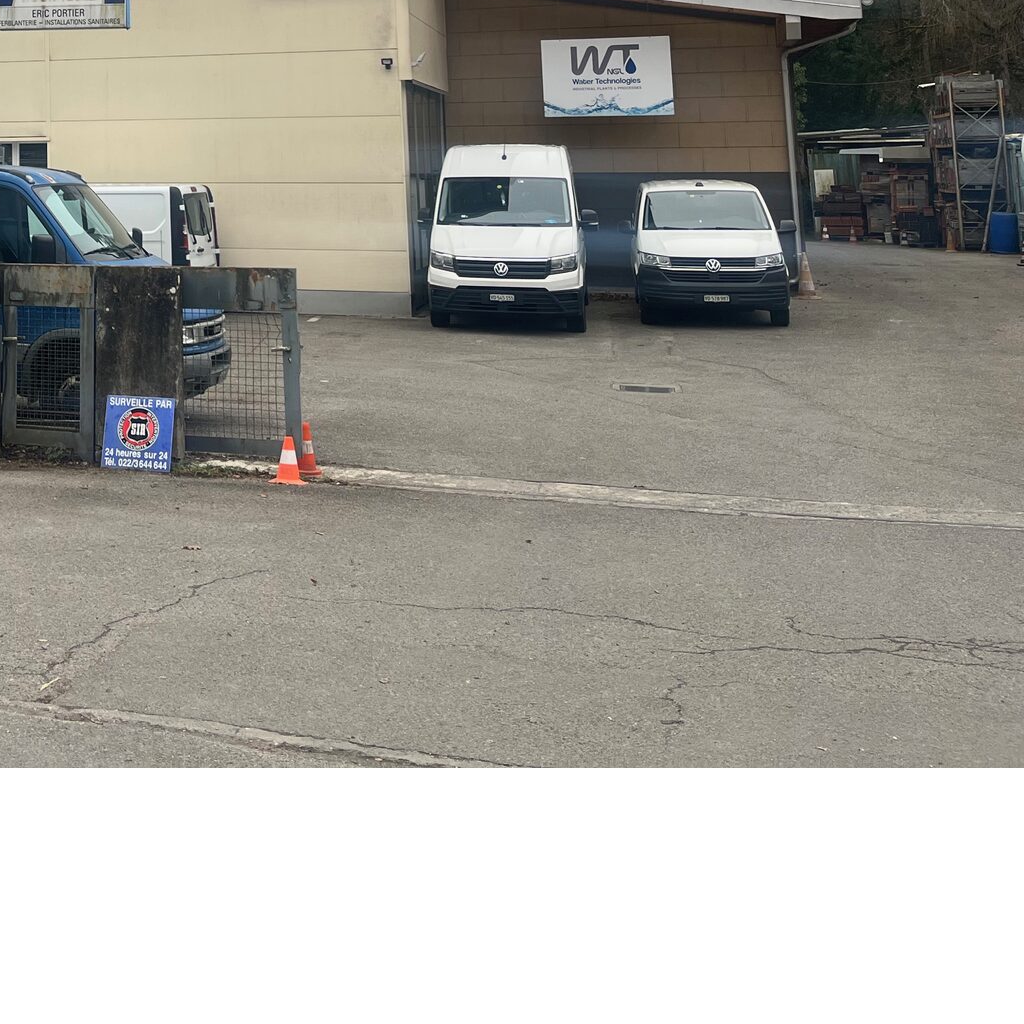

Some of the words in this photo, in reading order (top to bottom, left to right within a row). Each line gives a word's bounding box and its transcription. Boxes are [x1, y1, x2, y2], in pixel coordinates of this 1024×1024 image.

[32, 9, 50, 18] ERIC
[52, 8, 85, 18] PORTIER
[44, 18, 87, 26] INSTALLATIONS
[595, 77, 641, 86] Technologies
[110, 397, 153, 408] SURVEILLE
[156, 400, 172, 408] PAR
[105, 448, 114, 456] 24
[116, 448, 141, 458] heures
[159, 452, 168, 460] 24
[104, 457, 116, 466] Tél.
